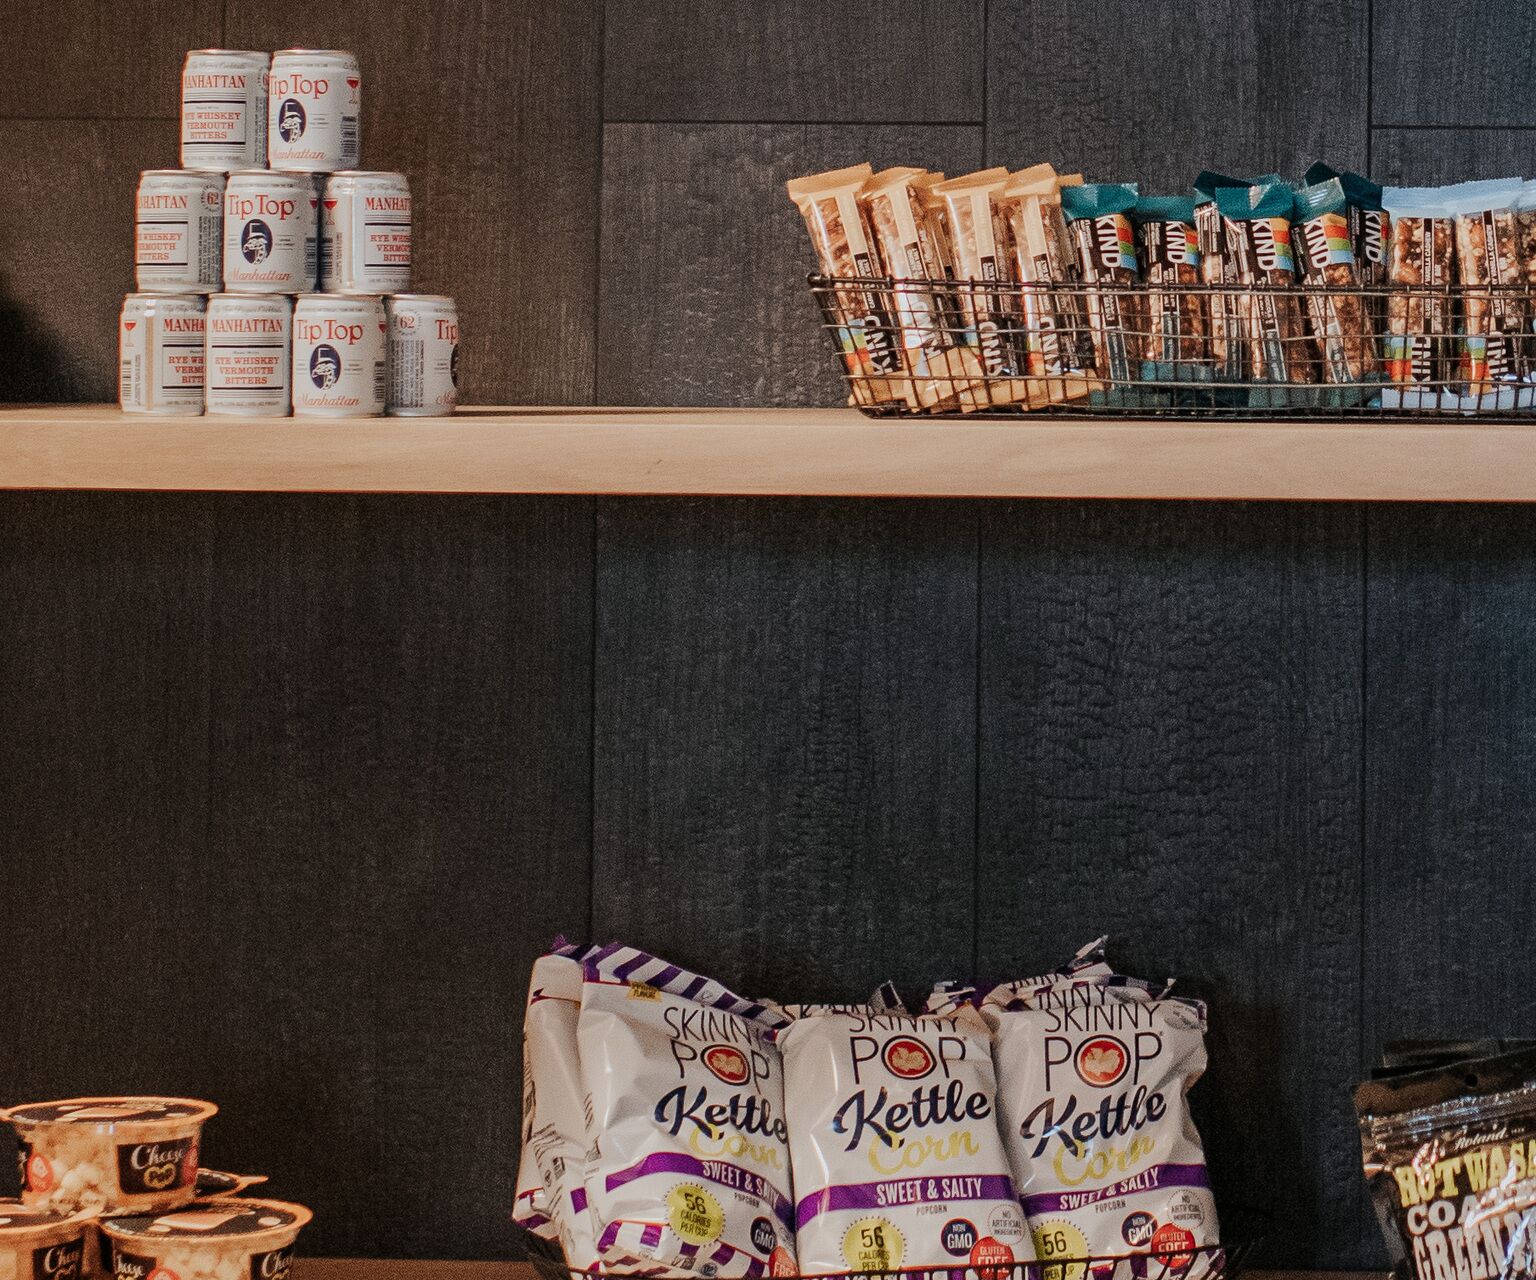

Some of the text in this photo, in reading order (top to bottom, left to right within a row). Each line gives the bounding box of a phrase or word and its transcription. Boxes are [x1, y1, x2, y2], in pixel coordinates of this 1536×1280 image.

[290, 74, 329, 99] Top
[197, 112, 241, 120] WHISKEY
[228, 194, 296, 221] Tip Top
[1095, 215, 1122, 268] KIND
[1165, 221, 1187, 264] KIND
[1250, 218, 1278, 271] KIND
[1303, 218, 1331, 269] KIND
[1363, 210, 1382, 263] KIND
[211, 318, 284, 333] MANHATTAN
[296, 319, 364, 345] Tip Top
[219, 366, 274, 375] VERMOUTH
[234, 356, 280, 365] WHISKEY
[225, 376, 268, 385] BITTERS
[1044, 1002, 1162, 1033] SKINNY
[671, 1039, 770, 1094] POP
[849, 1034, 967, 1085] POP
[1044, 1031, 1163, 1092] POP
[654, 1085, 787, 1145] Kettle
[832, 1079, 992, 1152] Kettle
[1019, 1084, 1168, 1160] Kettle
[689, 1122, 783, 1169] Corn
[868, 1129, 980, 1175] Corn
[1453, 1129, 1507, 1151] Roland
[130, 1143, 185, 1170] Cheese
[1053, 1134, 1156, 1187] Corn
[702, 1161, 754, 1192] SWEET &
[1059, 1166, 1160, 1211] SWEET & SALTY
[1395, 1157, 1462, 1208] HOT
[684, 1191, 707, 1215] 56
[876, 1177, 982, 1206] SWEET & SALTY
[1181, 1195, 1191, 1204] NO
[916, 1204, 948, 1217] POPCORN
[1002, 1210, 1012, 1219] NO
[1095, 1199, 1127, 1214] POPCORN
[952, 1223, 966, 1232] NON
[1131, 1216, 1146, 1225] NON
[754, 1229, 776, 1250] GMO
[860, 1226, 885, 1249] 56
[947, 1232, 973, 1250] GMO
[1042, 1230, 1067, 1256] 56
[1127, 1225, 1154, 1244] GMO
[1159, 1231, 1186, 1242] GLUTEN
[979, 1246, 1006, 1256] GLUTEN
[977, 1255, 1010, 1275] FREE
